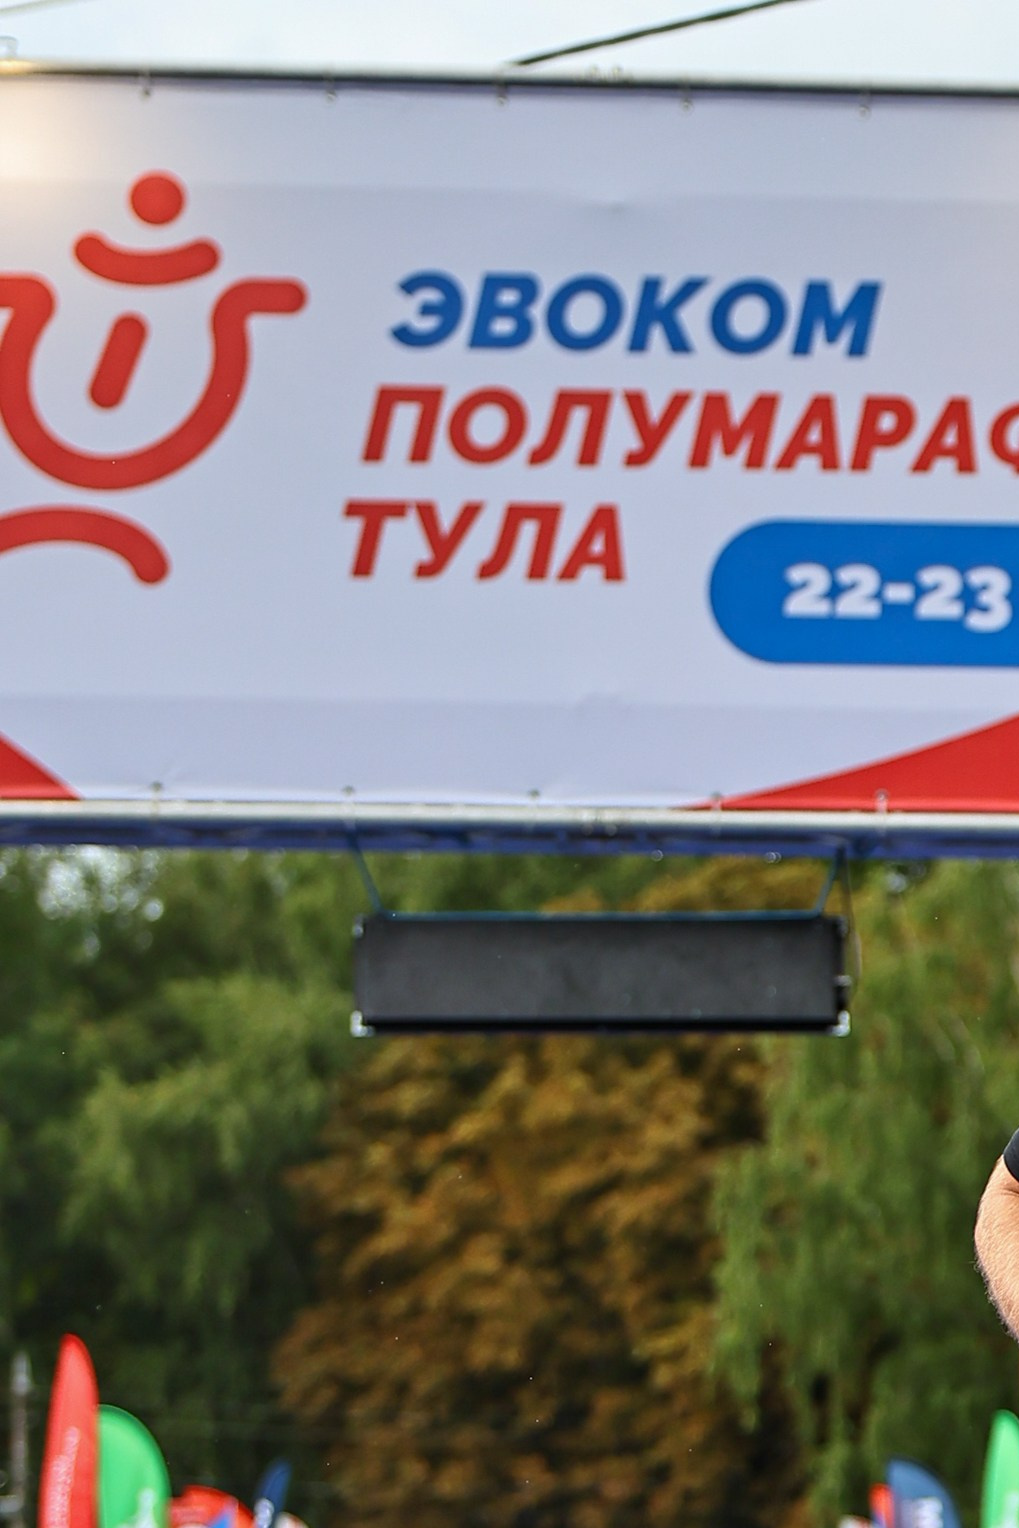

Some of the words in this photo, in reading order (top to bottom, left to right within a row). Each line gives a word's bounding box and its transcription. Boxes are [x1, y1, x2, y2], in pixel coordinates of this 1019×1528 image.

[391, 270, 882, 357] ЭВОКОМ
[343, 500, 625, 582] ТУЛА
[783, 562, 1012, 632] 22-23
